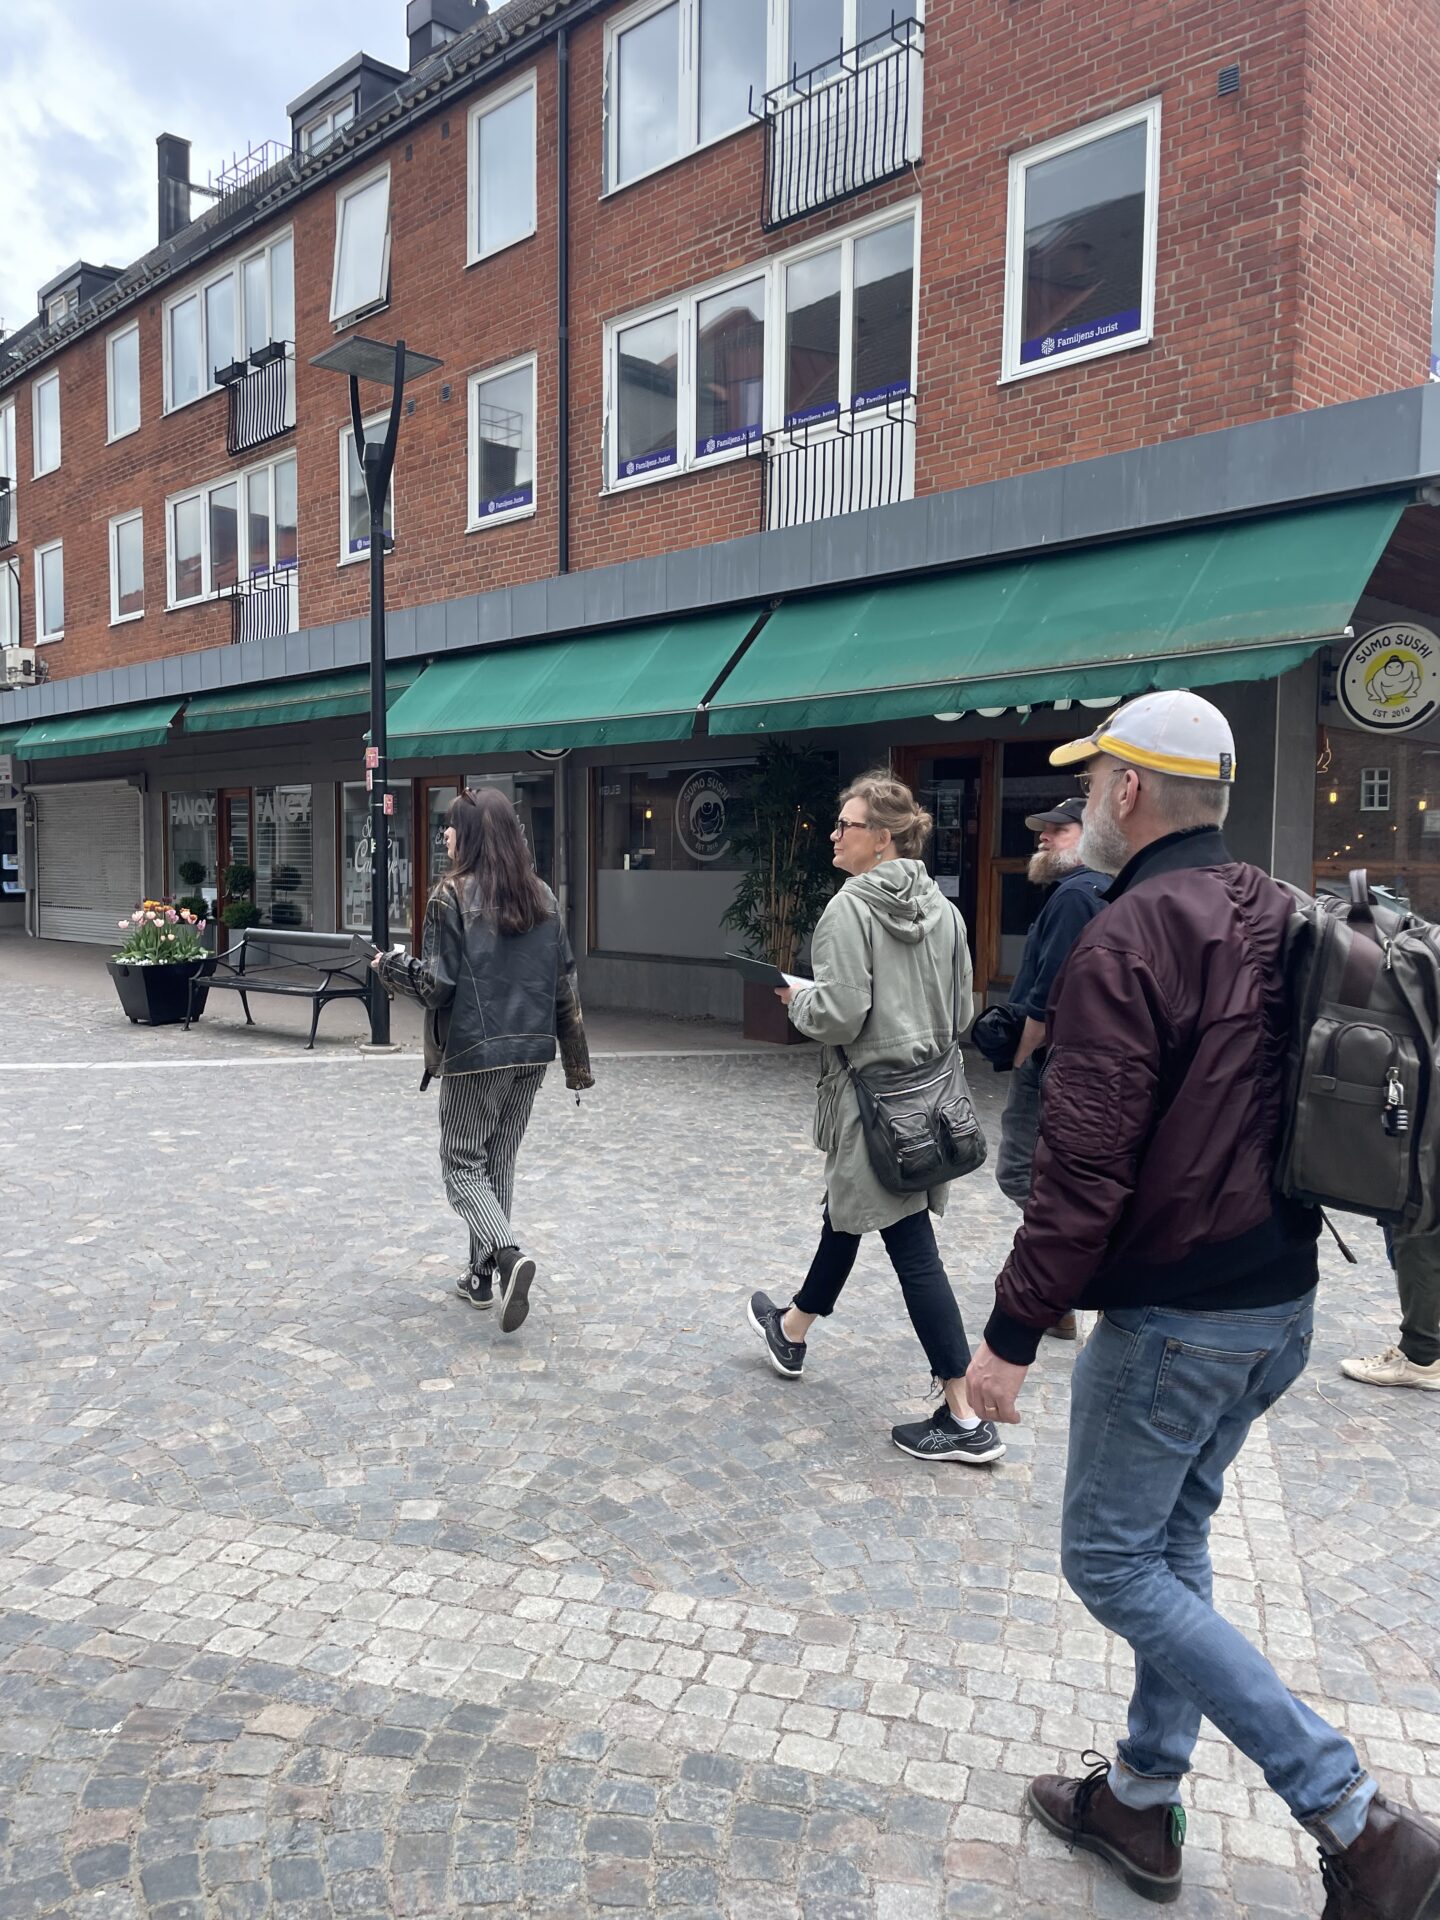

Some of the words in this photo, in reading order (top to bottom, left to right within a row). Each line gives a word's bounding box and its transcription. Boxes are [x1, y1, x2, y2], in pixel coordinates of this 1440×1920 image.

[1057, 331, 1094, 347] Familjens
[1095, 322, 1118, 335] Jurist
[1356, 636, 1391, 663] SUMO
[1395, 634, 1432, 659] SUSHI
[1372, 708, 1388, 719] EST
[684, 779, 705, 802] SUMO
[706, 777, 730, 801] SUSHI
[170, 795, 216, 829] FANCY
[256, 791, 311, 824] FANCY
